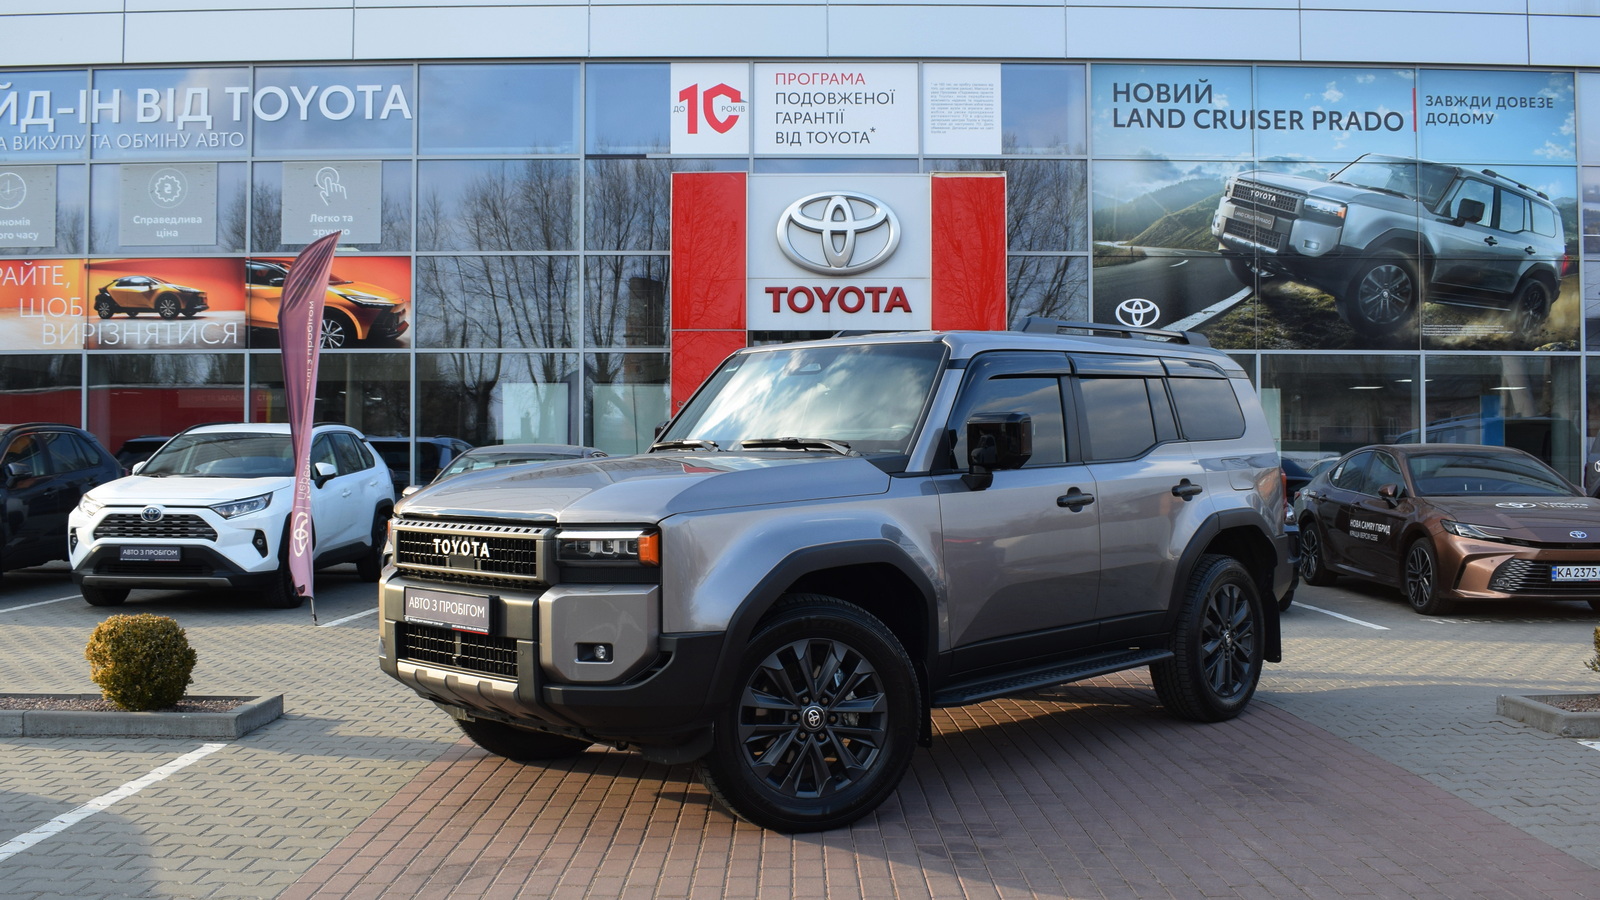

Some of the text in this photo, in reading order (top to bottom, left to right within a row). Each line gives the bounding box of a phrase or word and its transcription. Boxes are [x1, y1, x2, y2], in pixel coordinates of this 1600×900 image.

[774, 72, 866, 86] ПРОГРАМА
[774, 89, 896, 107] ПОДОВЖЕНОЇ
[1112, 78, 1213, 104] НОВИЙ
[136, 87, 213, 131] ВІД
[224, 84, 413, 122] TOYOTA
[673, 105, 686, 113] ДО
[721, 105, 746, 113] РОКІВ
[1425, 94, 1554, 110] ЗАВЖДИ ДОВЕЗЕ
[774, 109, 845, 125] ГАРАНТІЇ
[1112, 109, 1405, 132] LAND CRUISER PRADO
[1425, 112, 1495, 126] ДОДОМУ
[13, 135, 87, 151] ВИКУПУ
[91, 134, 112, 149] ТА
[116, 132, 192, 149] ОБМІНУ
[195, 131, 245, 148] АВТО
[774, 131, 802, 147] ВІД
[1250, 190, 1276, 202] TOYOTA
[132, 214, 203, 226] Справедлива
[309, 214, 341, 223] Легко
[16, 232, 40, 242] часу
[155, 228, 179, 241] ціна
[764, 286, 913, 314] TOYOTA
[19, 297, 84, 322] ЩОБ
[41, 322, 239, 347] ВИРІЗНЯТИСЯ
[432, 538, 491, 558] TOYOTA
[1557, 567, 1572, 577] KA
[1574, 567, 1598, 577] 2375
[408, 596, 485, 618] АВТО З ПРОБІГОМ
